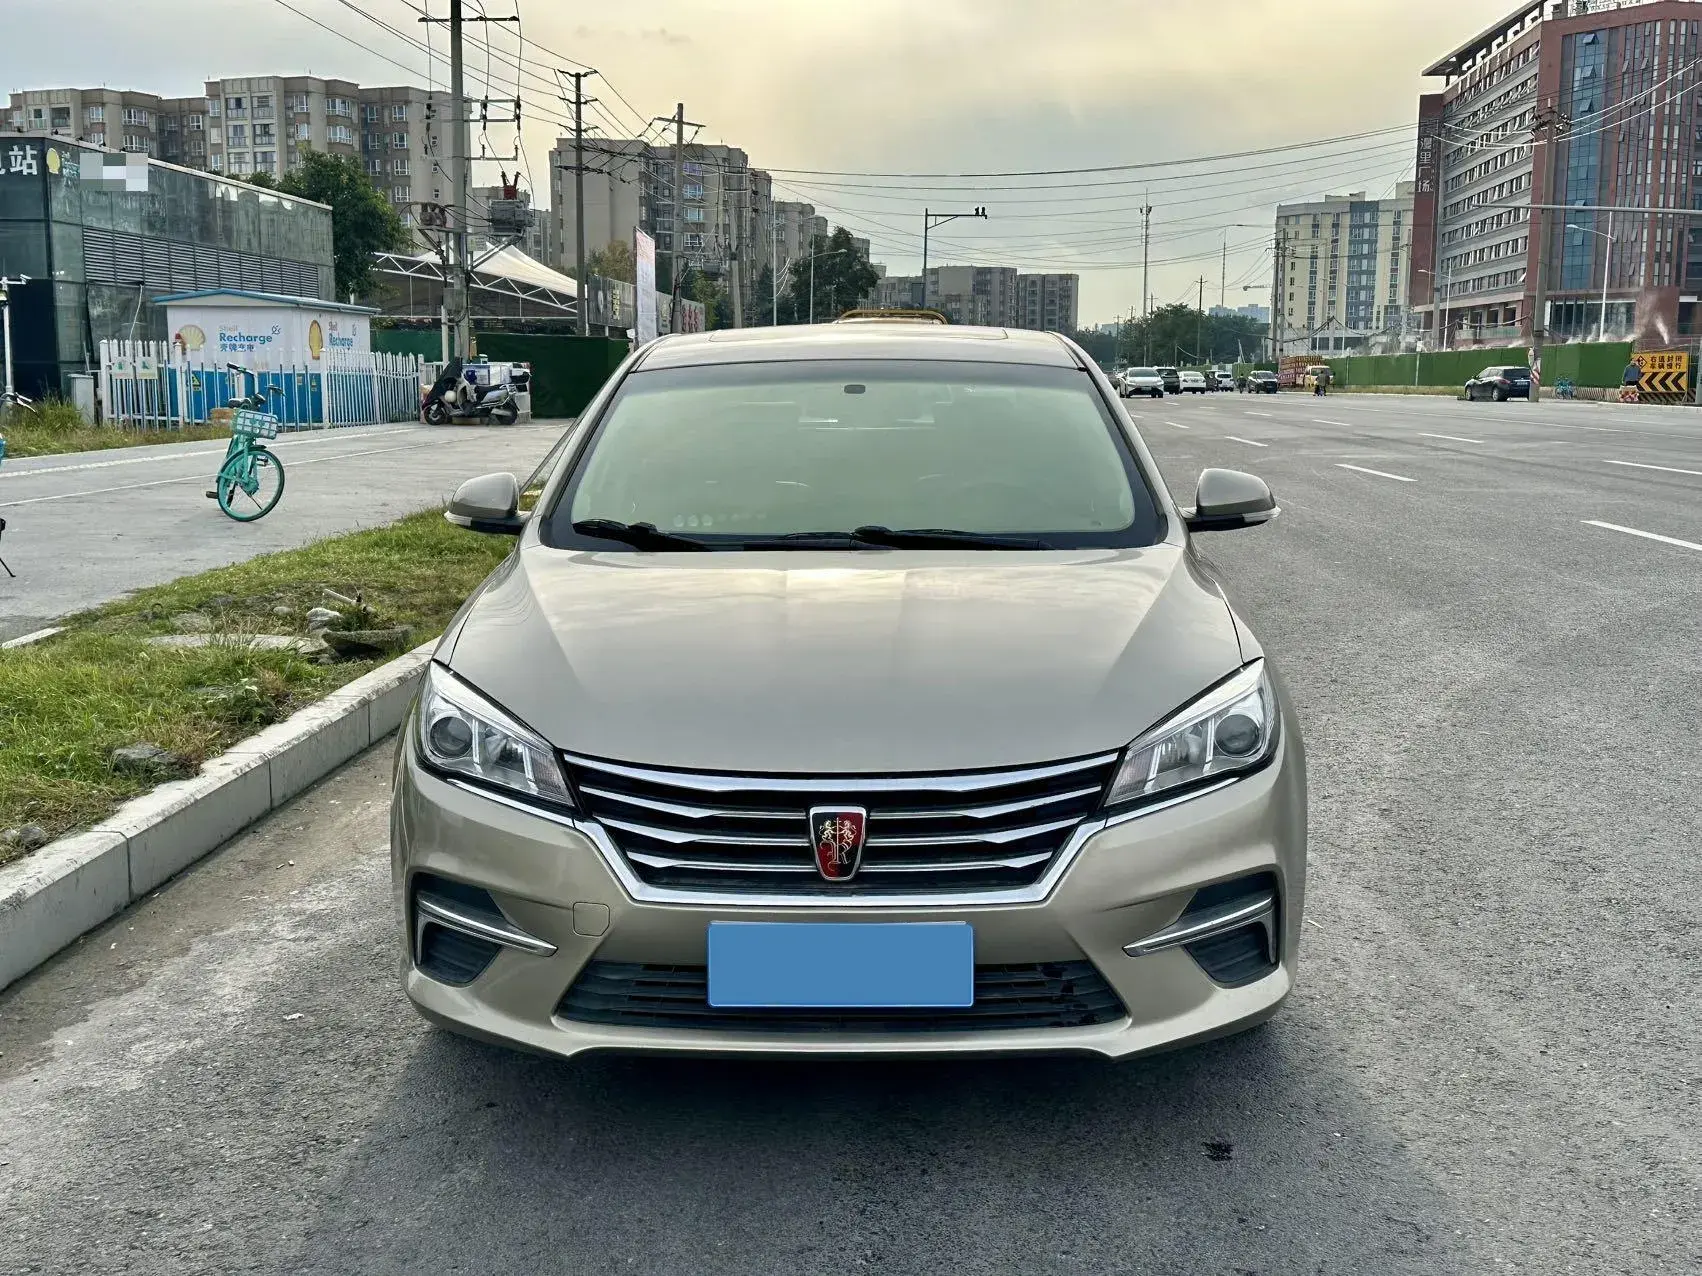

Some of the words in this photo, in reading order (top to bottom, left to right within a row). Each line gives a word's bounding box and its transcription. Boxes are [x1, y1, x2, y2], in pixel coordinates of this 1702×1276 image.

[0, 144, 38, 175] 站
[219, 332, 273, 345] Recharge
[328, 333, 353, 346] Recharge
